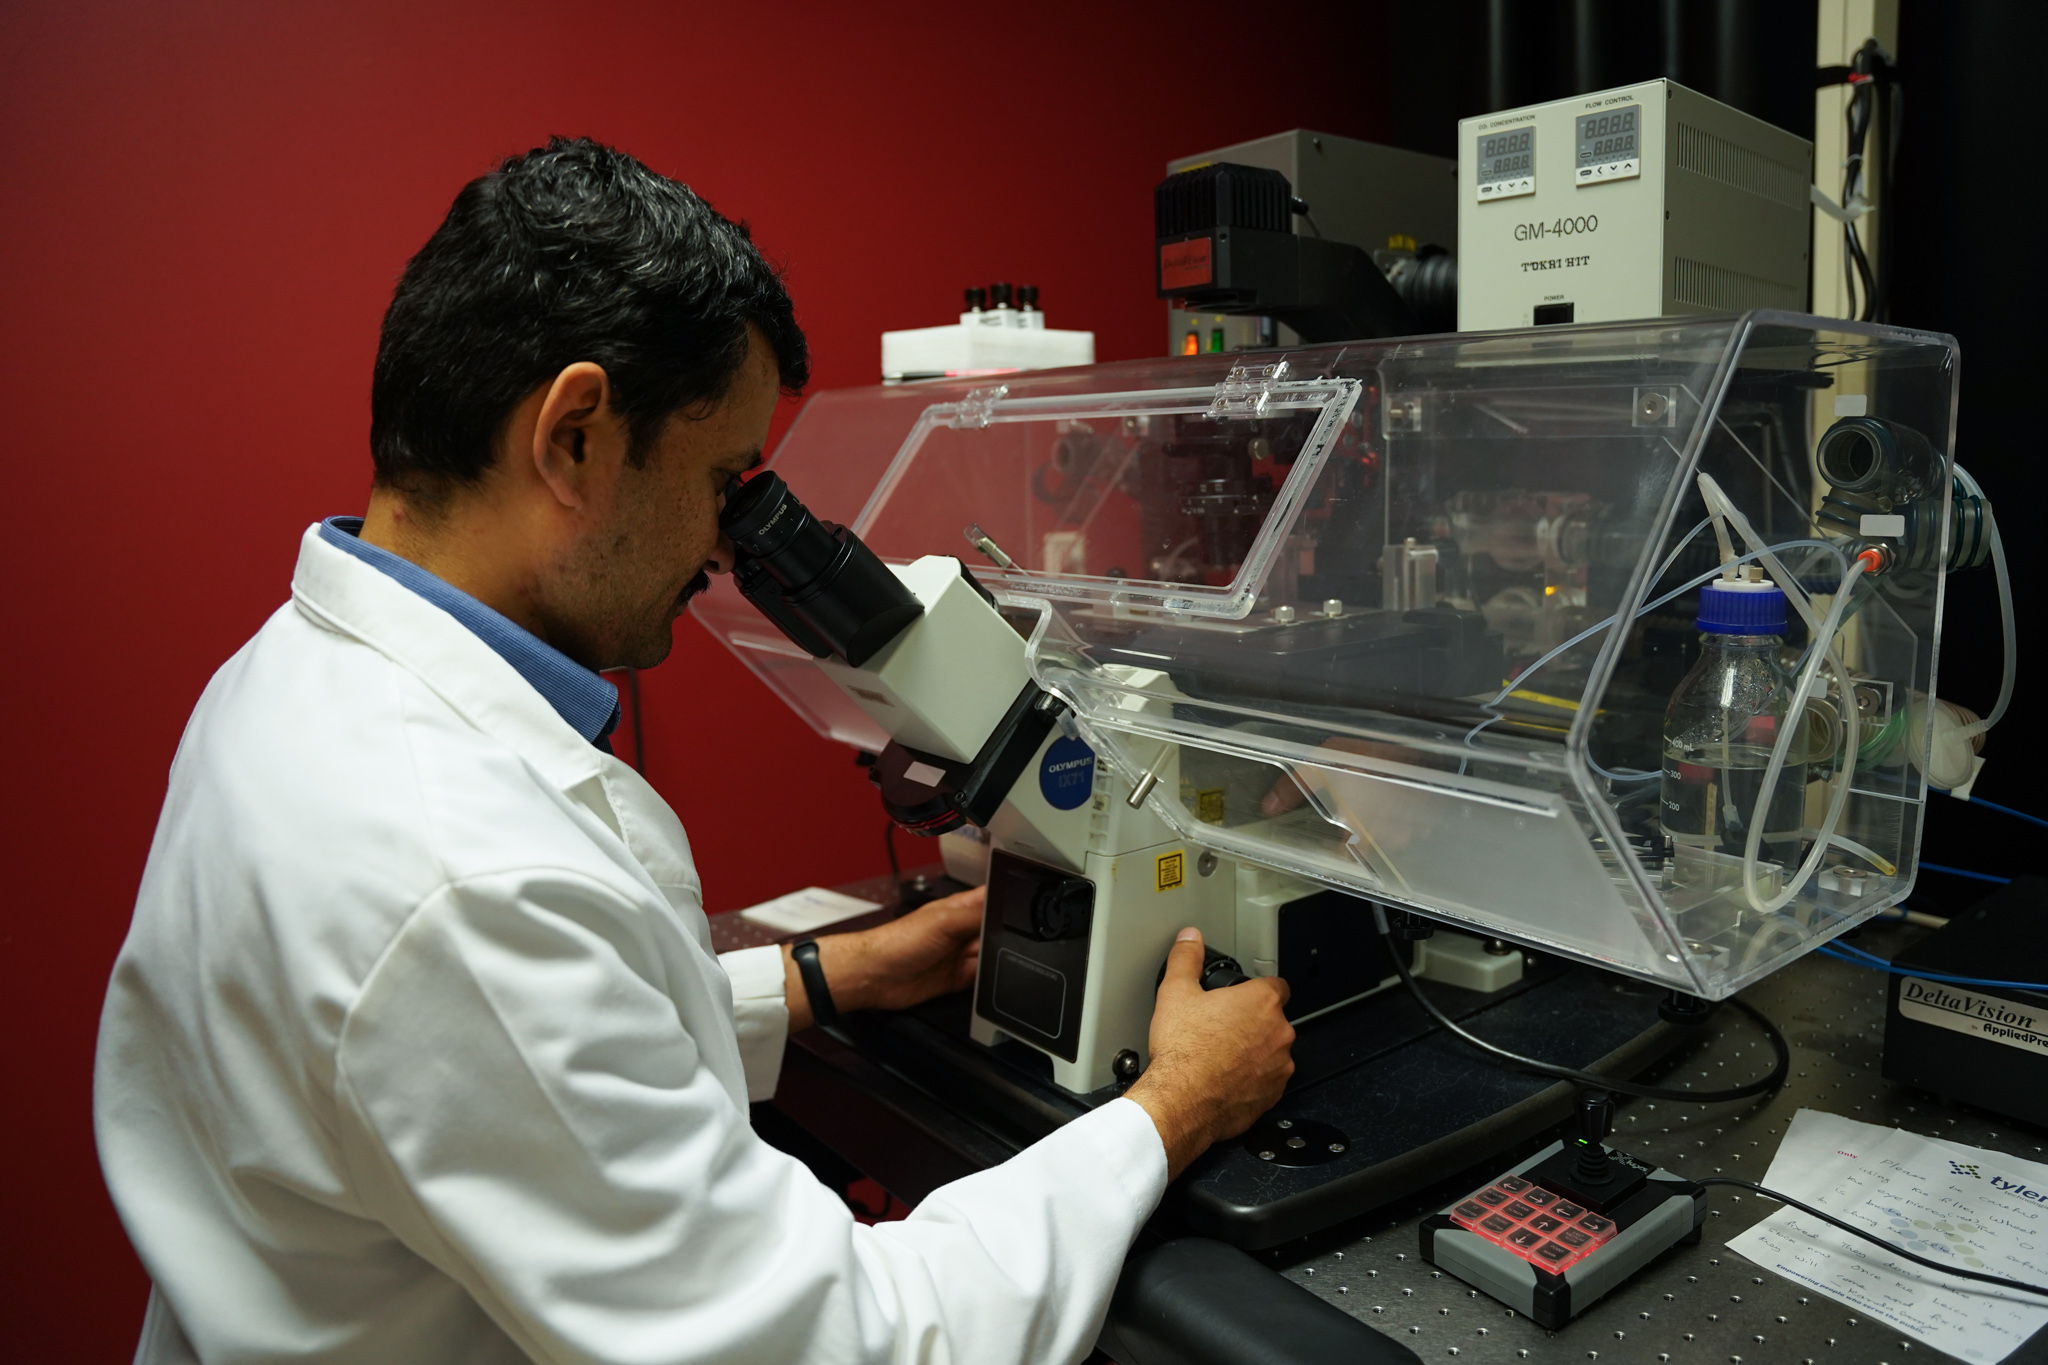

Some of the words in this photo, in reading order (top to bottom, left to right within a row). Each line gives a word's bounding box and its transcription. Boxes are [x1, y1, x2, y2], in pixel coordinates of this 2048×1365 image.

[1585, 101, 1603, 109] FLOW
[1605, 95, 1634, 106] CONTROL
[1490, 114, 1536, 128] CONCENTRATION
[1514, 214, 1598, 241] GM-4000
[1565, 255, 1590, 268] HIT
[1544, 294, 1565, 302] POWER
[758, 503, 788, 536] OLYMPUS
[1672, 739, 1683, 750] 400
[1048, 757, 1093, 773] OLYMPUS
[1058, 770, 1086, 788] IX71
[1670, 769, 1682, 780] 300
[1668, 801, 1680, 812] 200
[1837, 1150, 1858, 1159] Only
[1880, 1159, 1926, 1181] Please
[1979, 1196, 2038, 1219] careful
[1990, 1176, 2048, 1203] tyler
[1776, 1263, 1820, 1286] Empowering
[1820, 1283, 1845, 1298] people
[1846, 1295, 1863, 1305] who
[1863, 1302, 1884, 1314] serve
[1885, 1311, 1899, 1322] the
